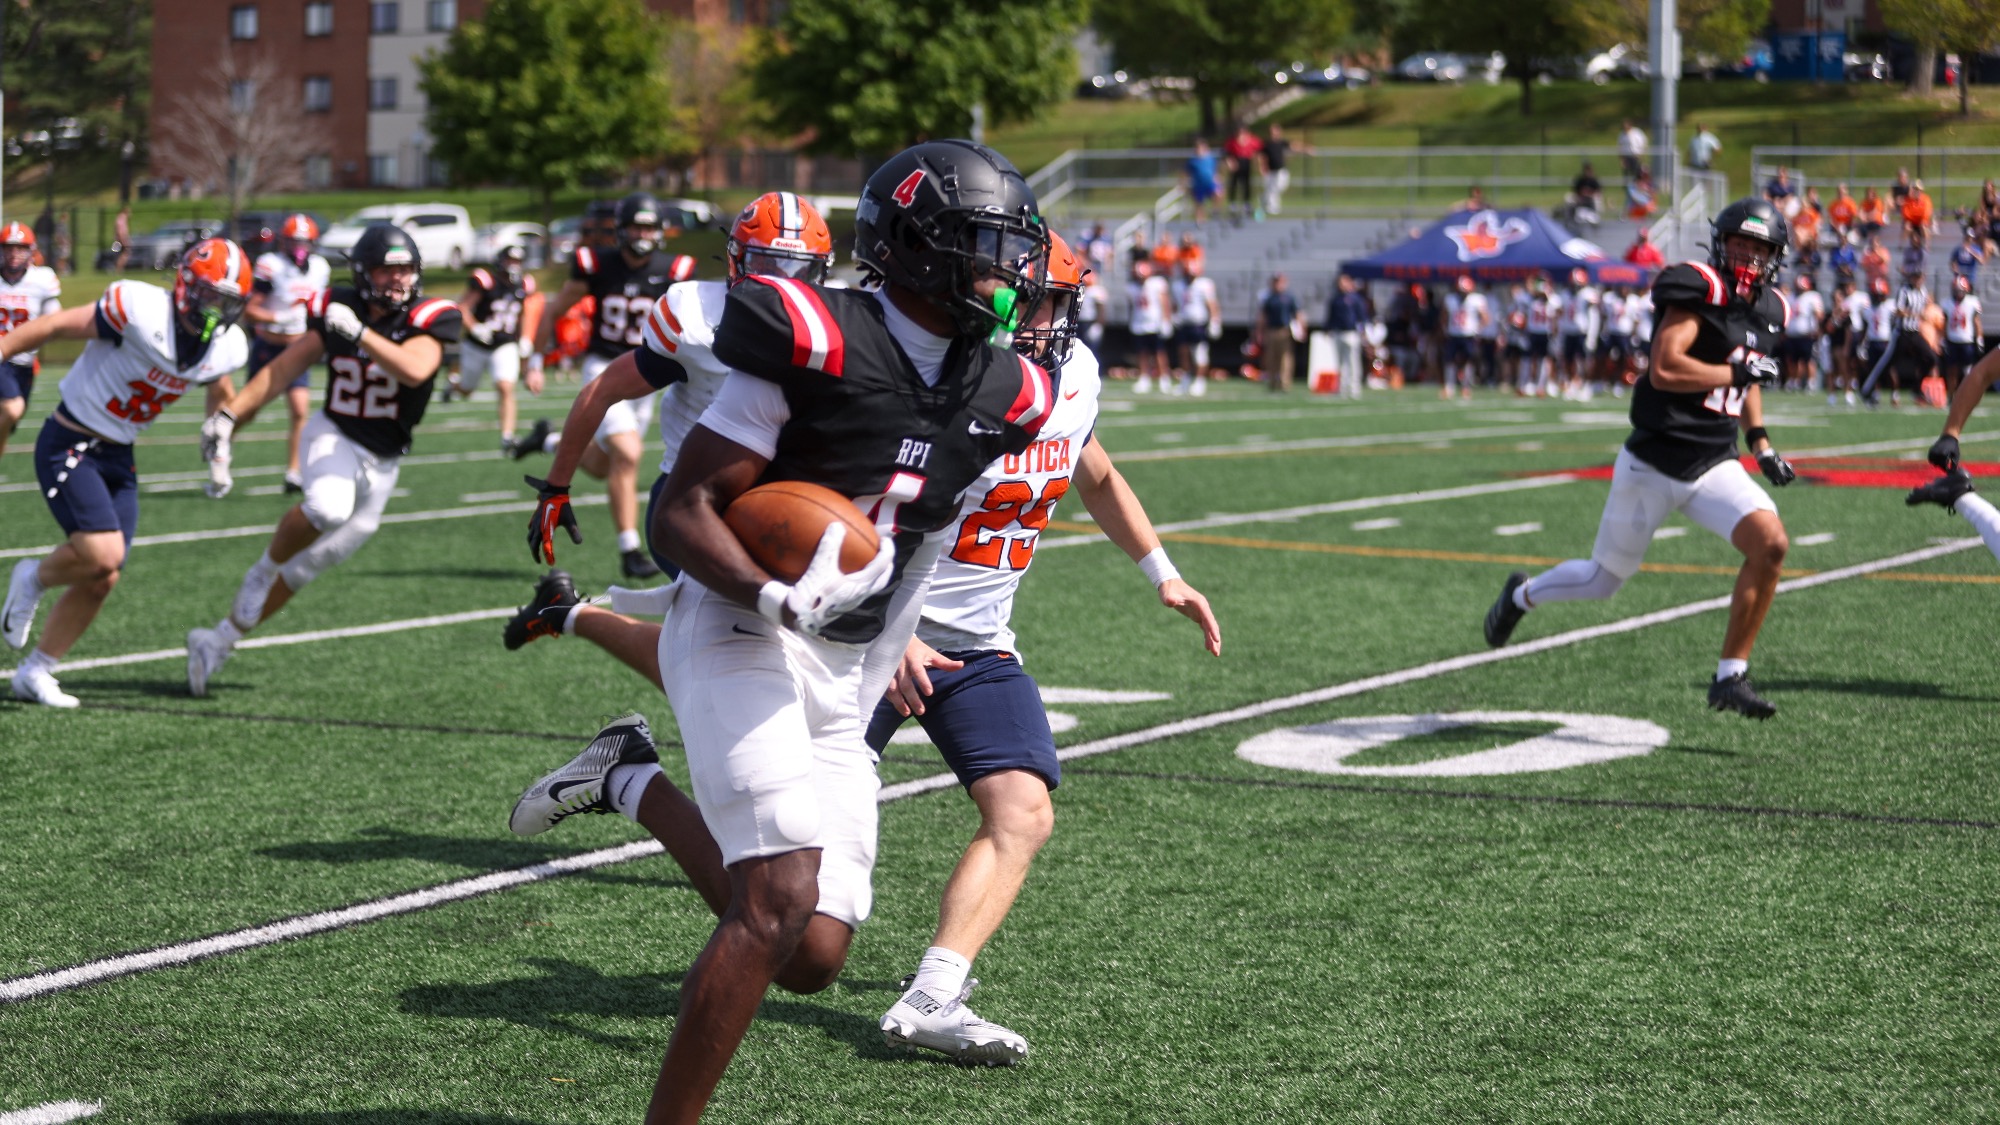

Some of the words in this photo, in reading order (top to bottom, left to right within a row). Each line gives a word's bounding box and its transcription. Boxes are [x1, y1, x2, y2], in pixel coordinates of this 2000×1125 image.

[892, 168, 927, 208] 4
[600, 294, 656, 346] 93
[329, 355, 399, 421] 22
[894, 438, 932, 468] RPI
[1003, 439, 1070, 475] UTICA
[851, 470, 928, 536] 4
[949, 475, 1070, 570] 29
[902, 989, 943, 1017] NIKE
